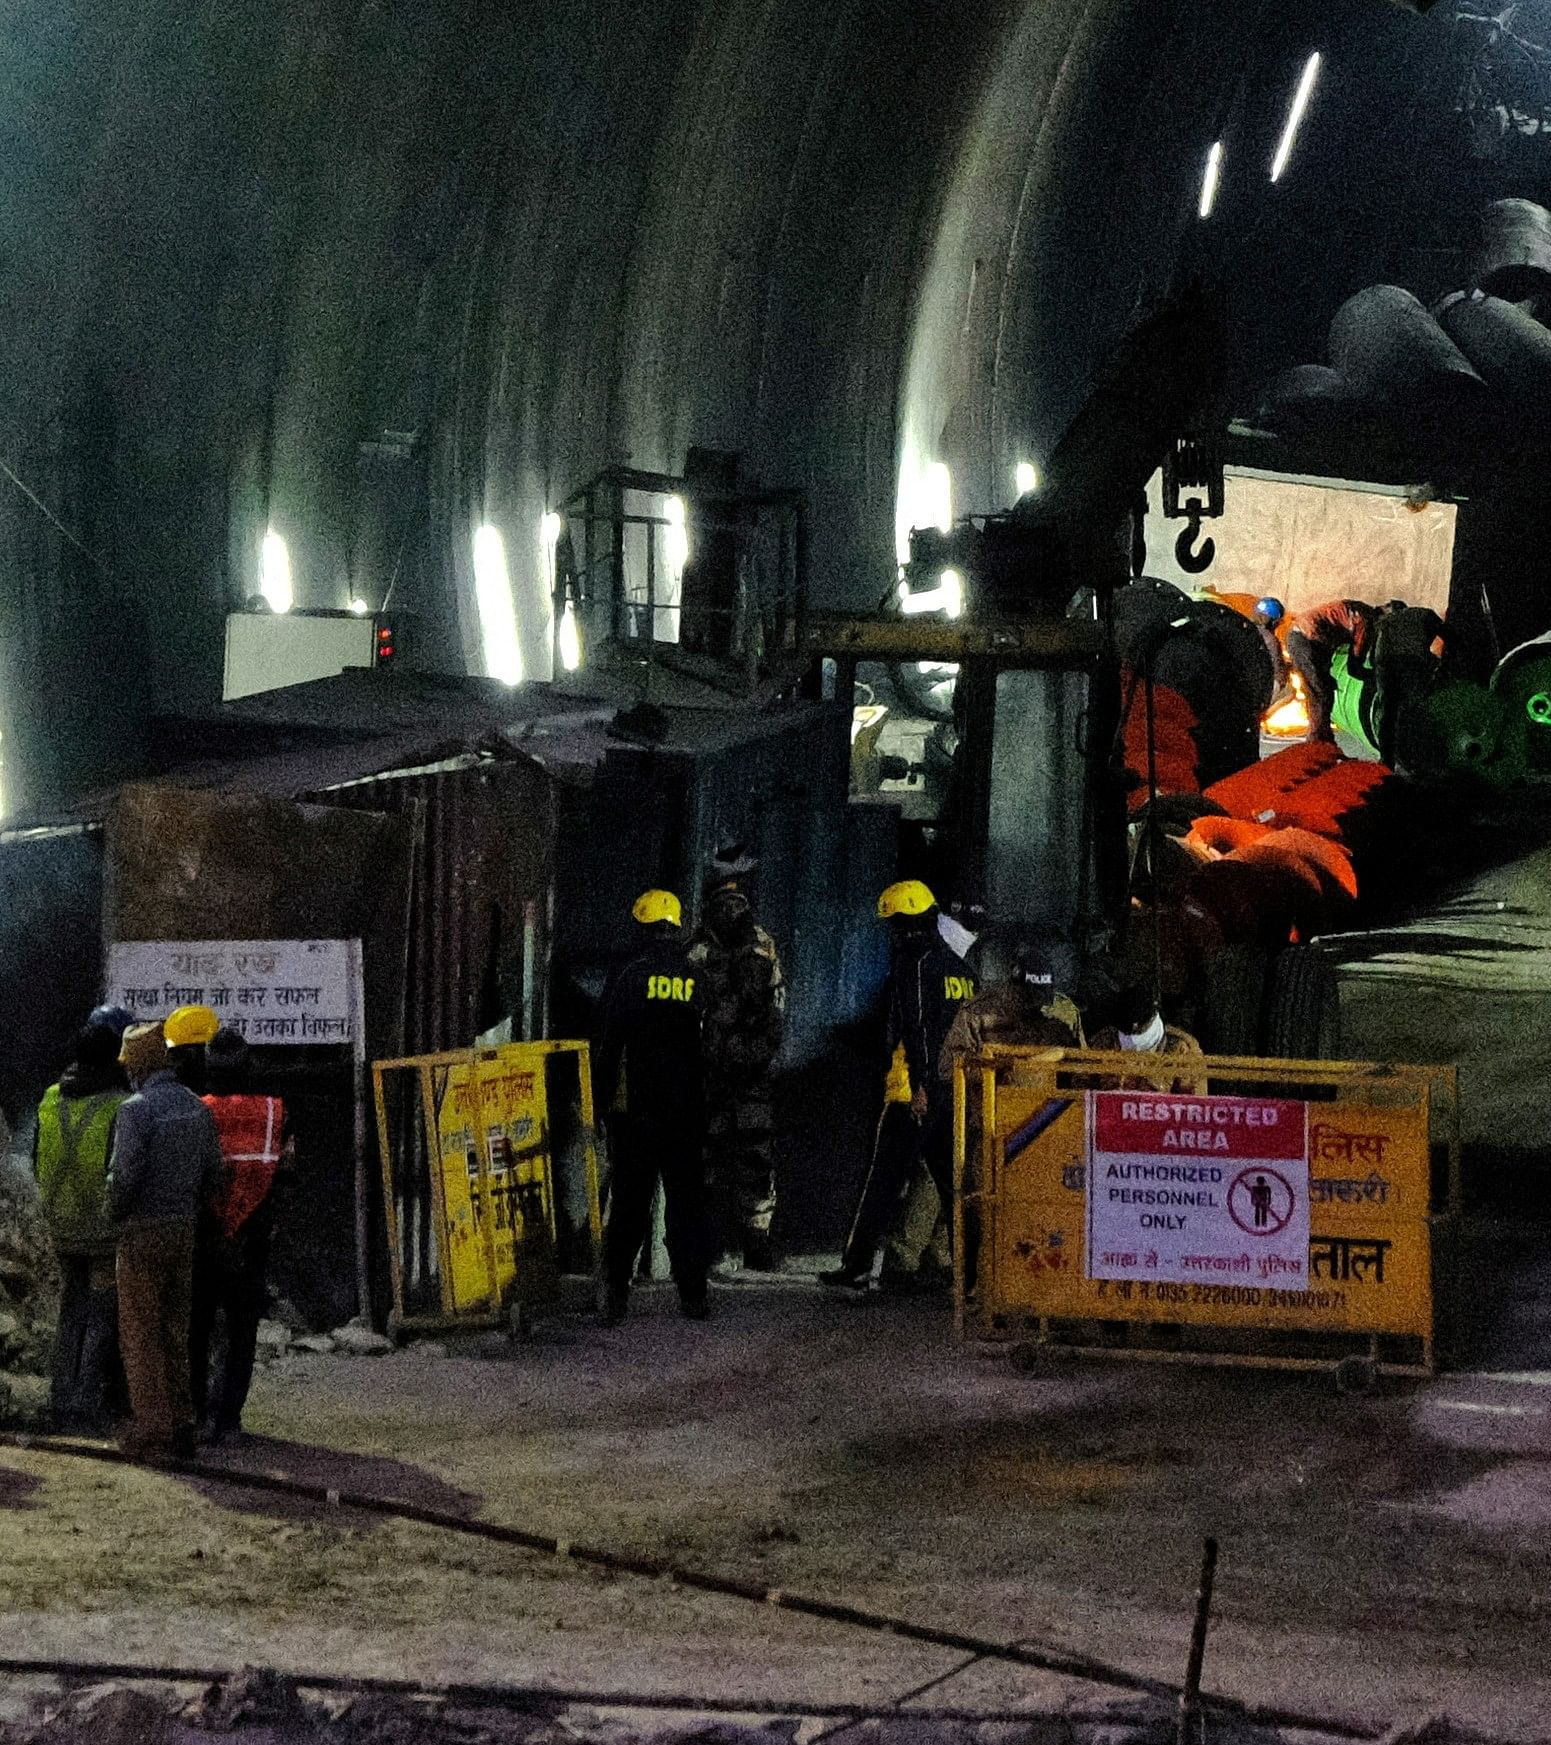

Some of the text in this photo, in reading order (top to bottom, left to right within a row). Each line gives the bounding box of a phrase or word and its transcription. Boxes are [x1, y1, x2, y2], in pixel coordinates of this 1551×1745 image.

[646, 974, 696, 1002] SDRF
[1122, 1101, 1279, 1126] RESTRICTED
[1162, 1129, 1230, 1150] AREA
[1106, 1164, 1223, 1183] AUTHORIZED
[1109, 1188, 1219, 1207] PERSONNEL
[1139, 1213, 1188, 1231] ONLY
